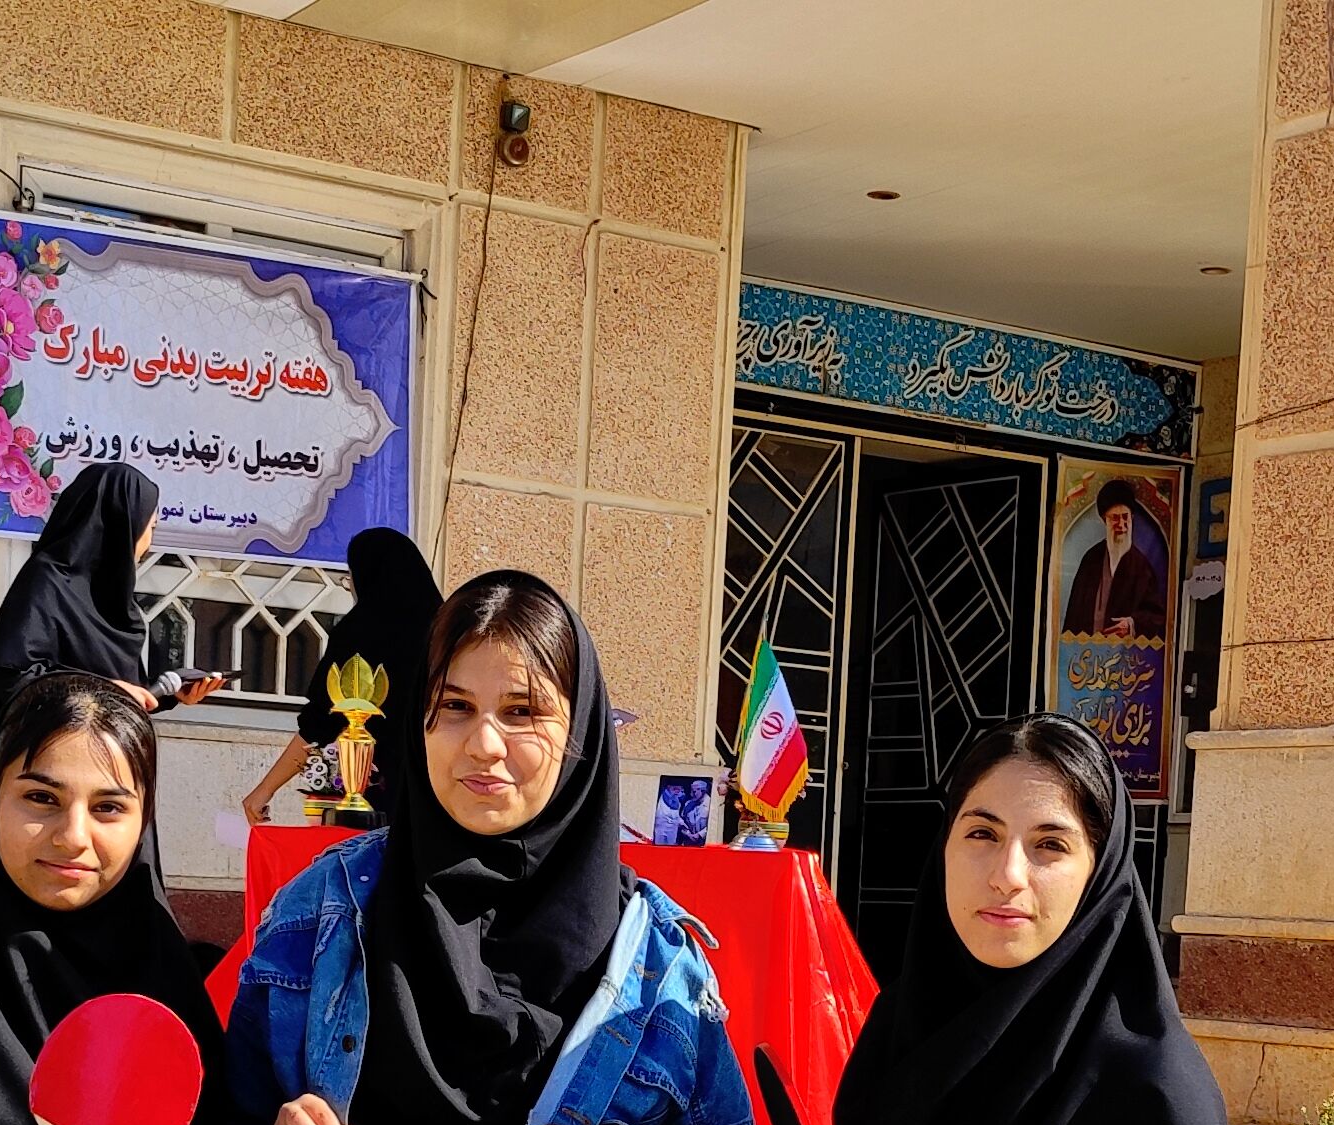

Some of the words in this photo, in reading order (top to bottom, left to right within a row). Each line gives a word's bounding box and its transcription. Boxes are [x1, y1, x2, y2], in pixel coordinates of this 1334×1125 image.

[43, 323, 126, 376] مبارک
[133, 335, 198, 387] بدنی
[204, 351, 274, 397] تربیت
[278, 356, 329, 393] هفته
[45, 416, 123, 461] ورزش
[146, 430, 221, 468] تهذیب
[243, 439, 321, 476] تحصیل
[159, 501, 185, 522] نمو
[188, 504, 258, 528] دبیرستان
